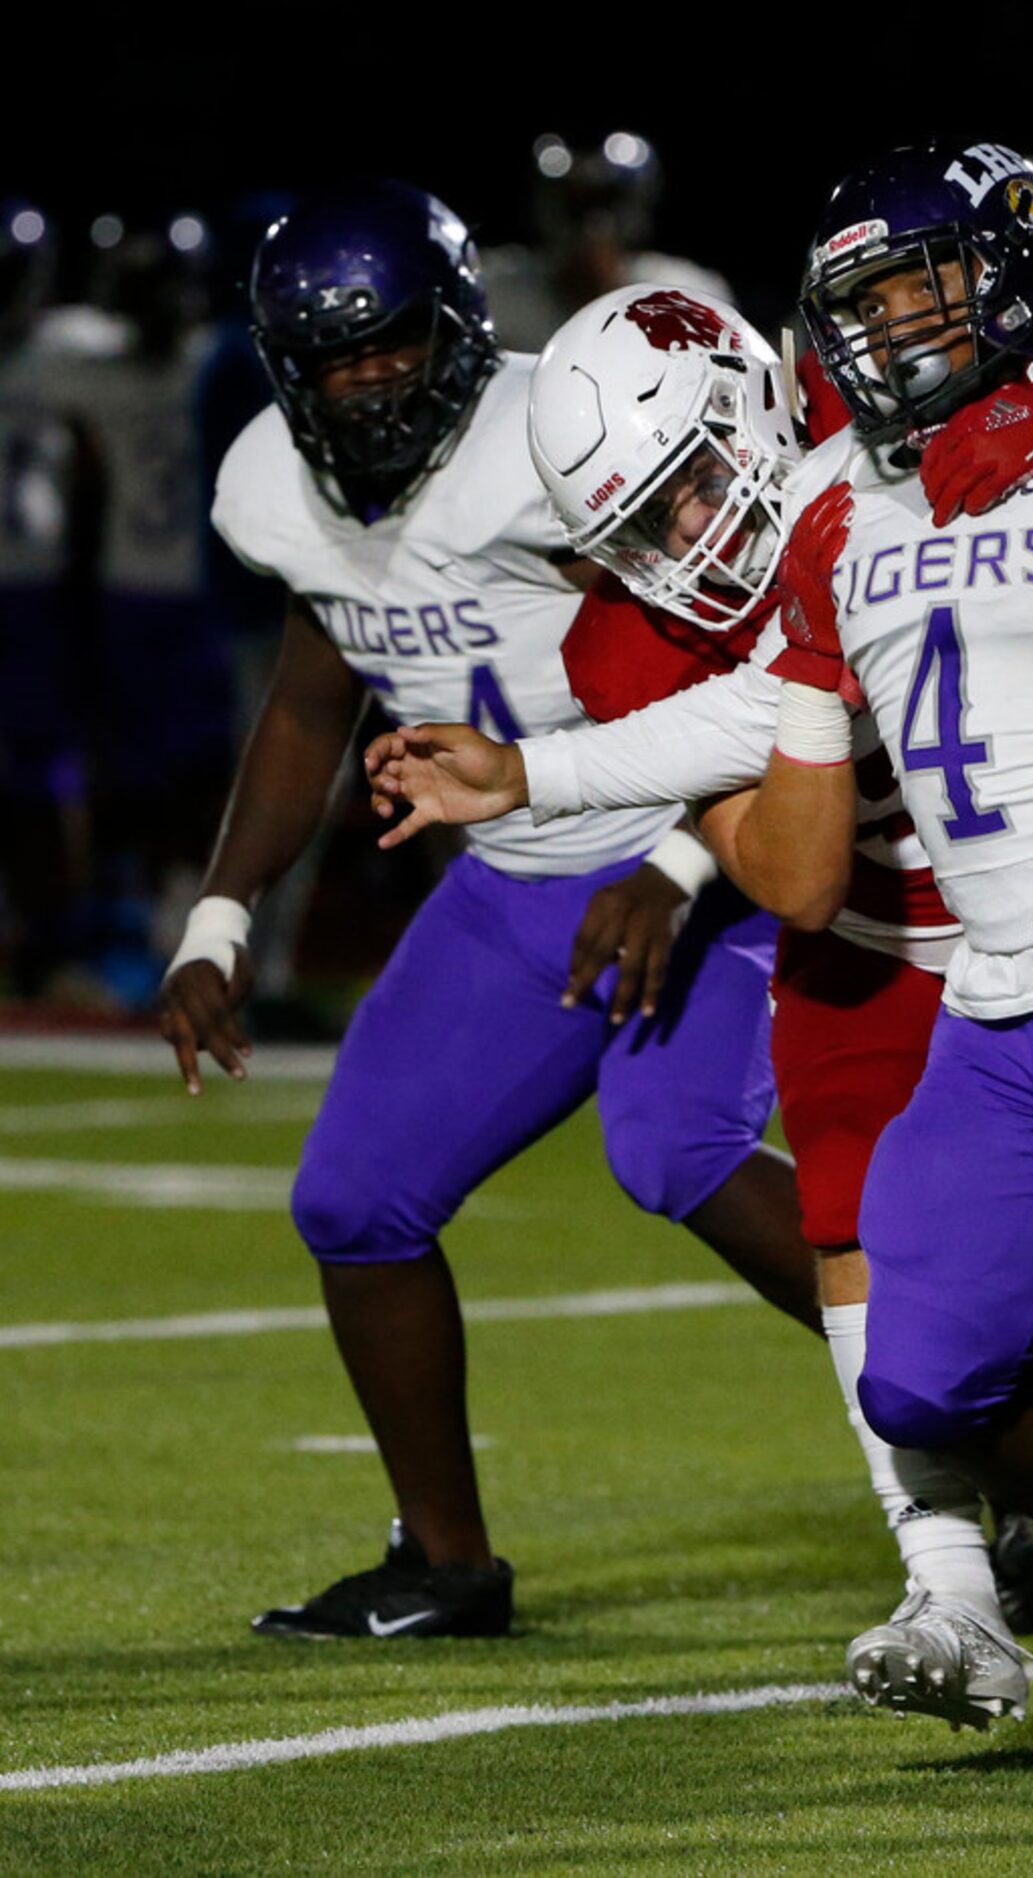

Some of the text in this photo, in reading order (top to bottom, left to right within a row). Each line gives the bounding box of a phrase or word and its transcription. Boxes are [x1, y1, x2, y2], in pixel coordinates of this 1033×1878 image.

[828, 225, 867, 251] Riddell
[586, 473, 625, 511] LIONS
[900, 600, 1014, 842] 4
